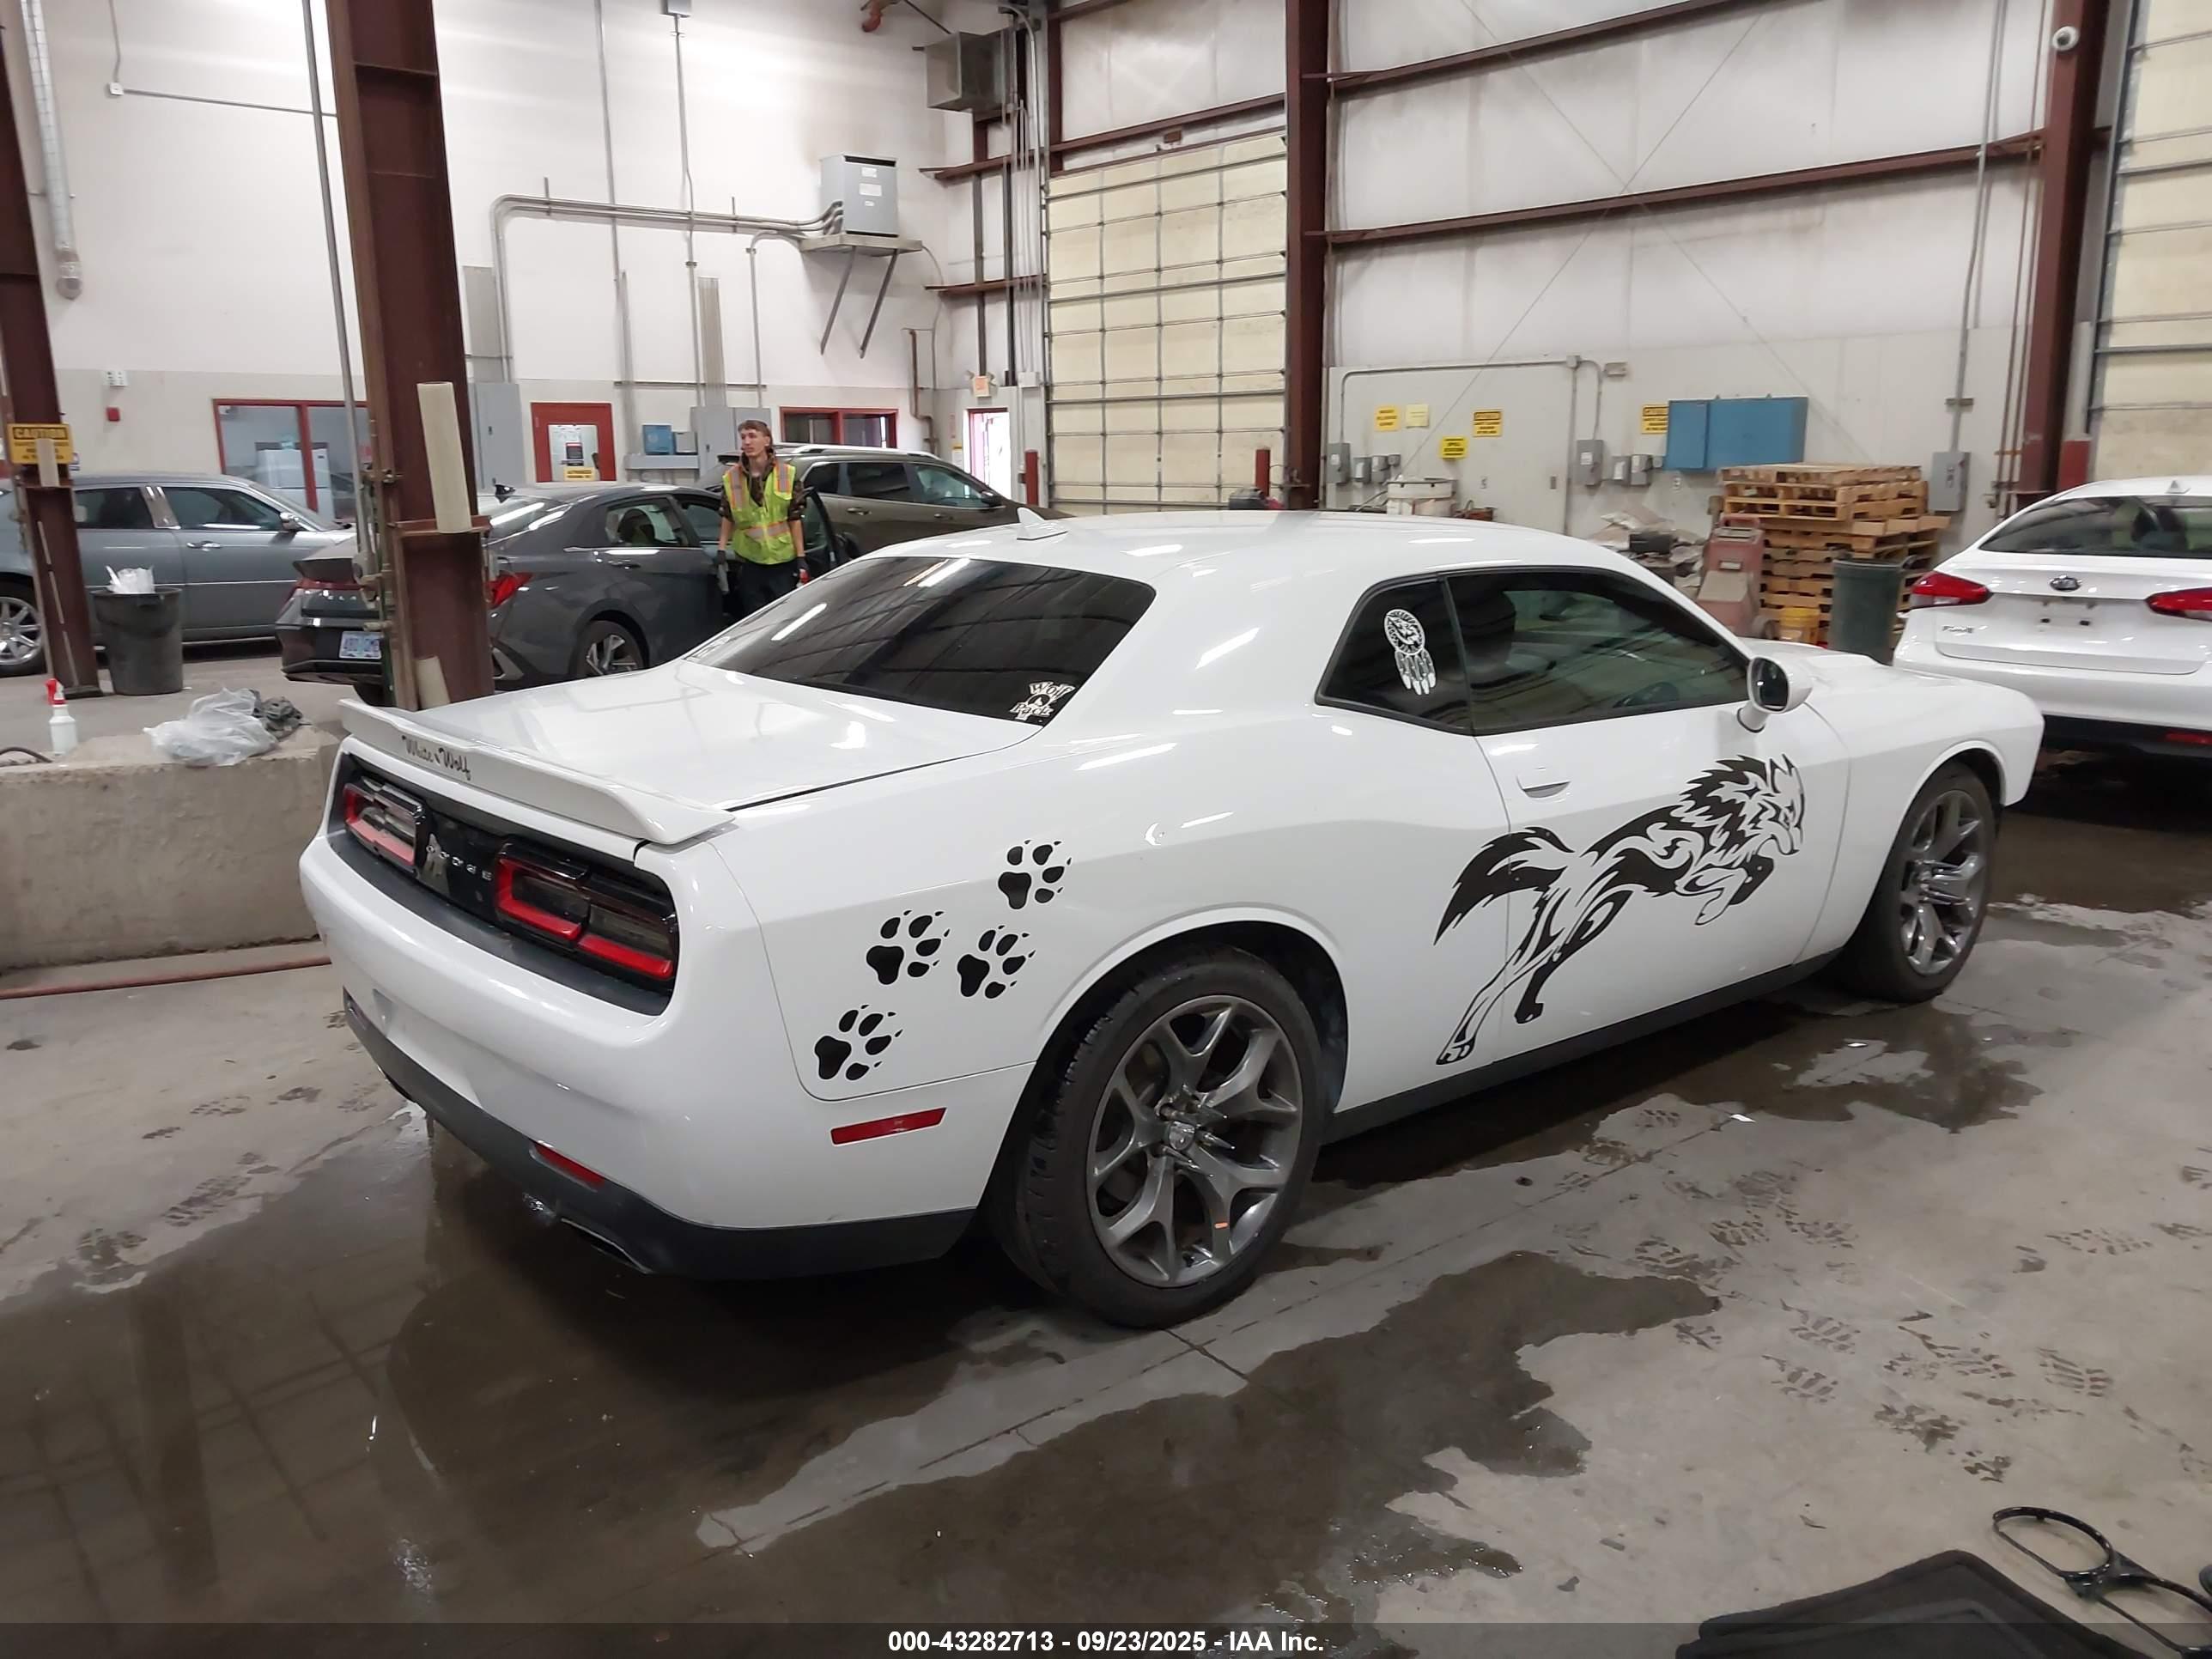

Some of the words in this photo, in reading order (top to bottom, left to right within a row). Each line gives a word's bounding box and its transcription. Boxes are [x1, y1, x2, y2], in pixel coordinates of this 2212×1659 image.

[1029, 680, 1076, 702] Wolf
[1009, 702, 1054, 719] Pack
[437, 747, 471, 781] Wolf
[426, 845, 493, 881] DODGE
